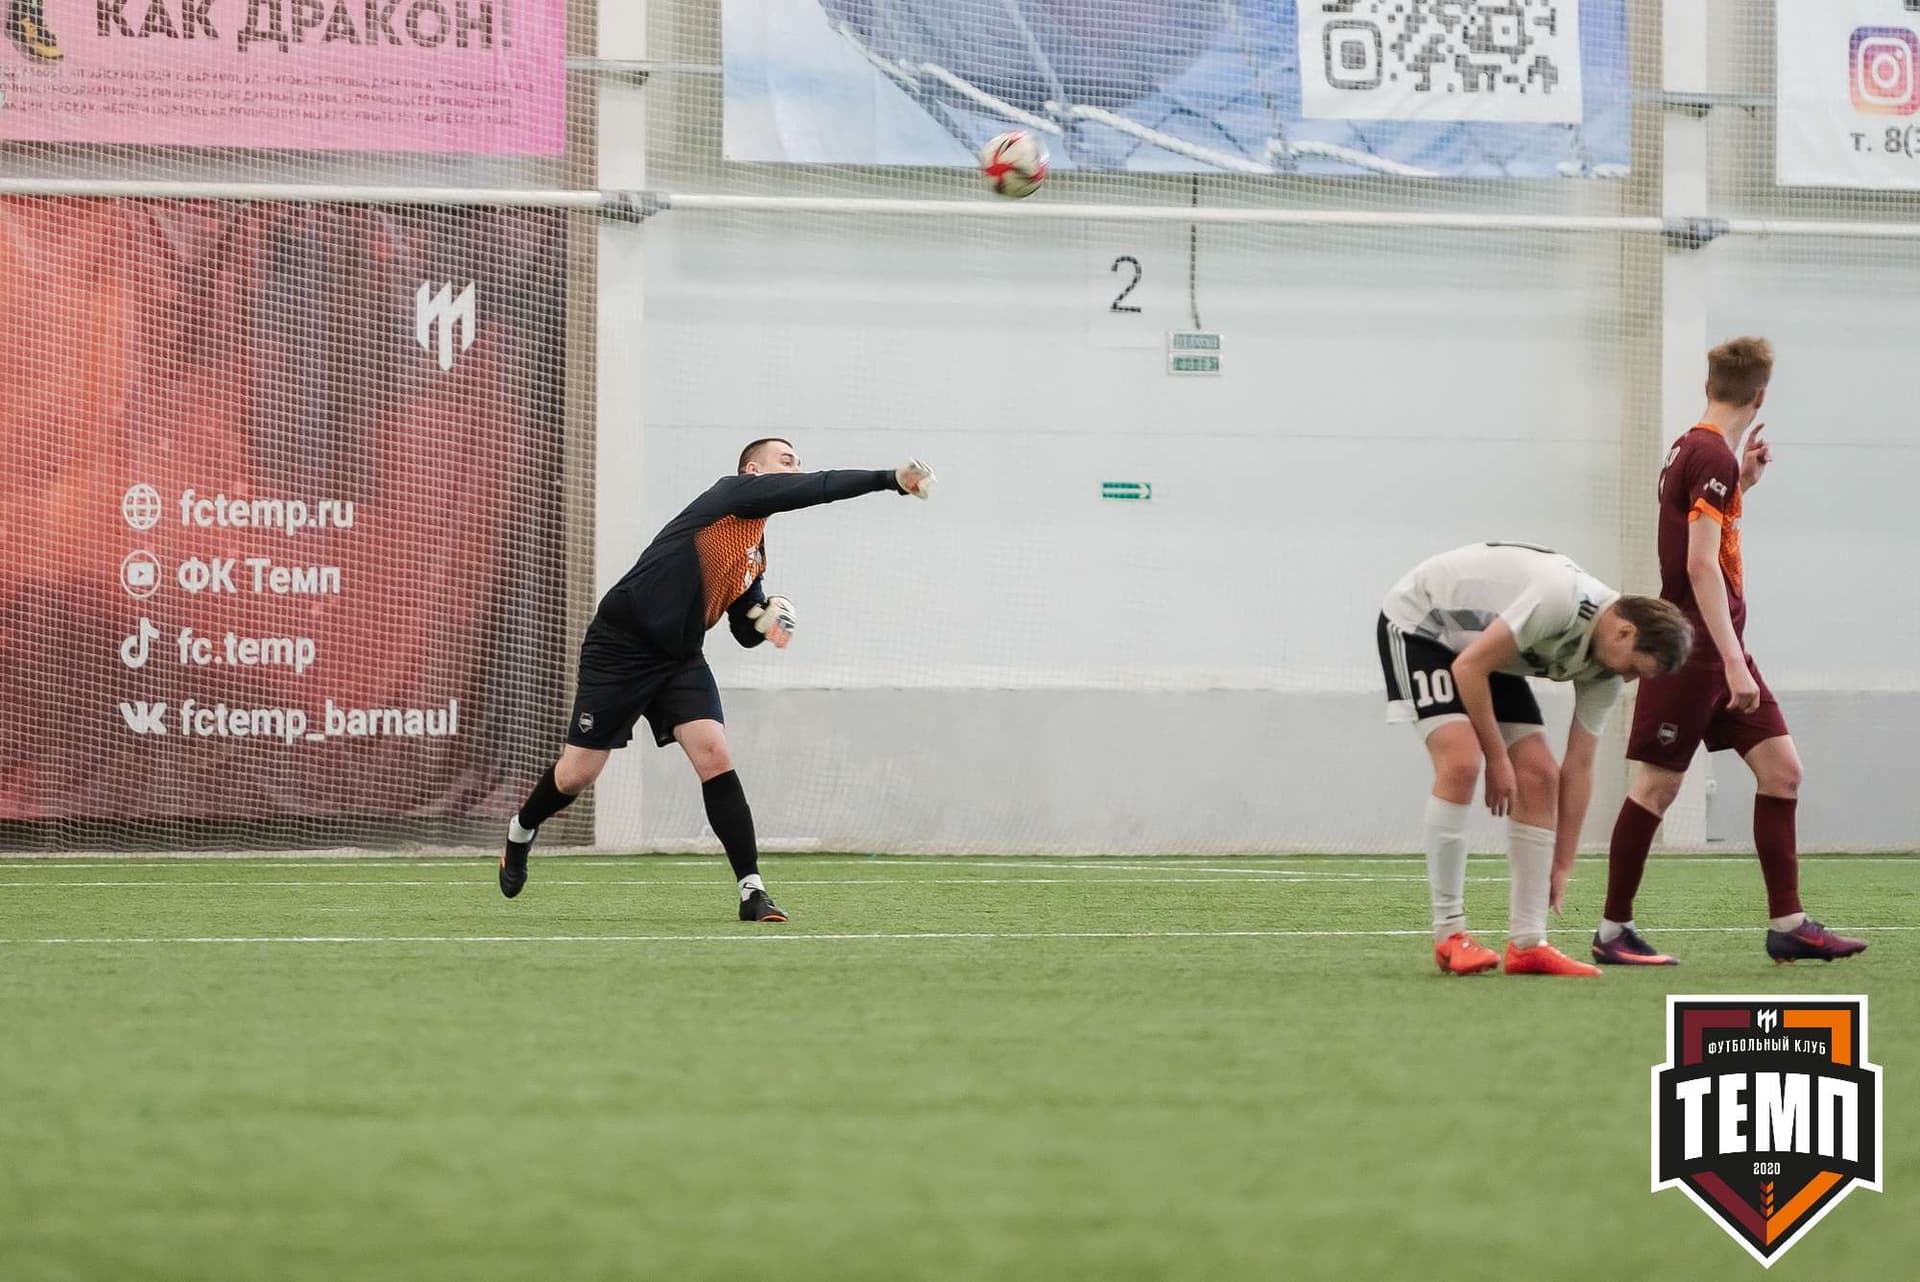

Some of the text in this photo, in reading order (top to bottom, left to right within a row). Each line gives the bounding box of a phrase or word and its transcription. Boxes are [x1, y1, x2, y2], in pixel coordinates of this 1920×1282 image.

[96, 0, 513, 54] КАК ДРАКОН!
[1110, 256, 1142, 313] 2
[179, 488, 355, 536] fctemp.ru
[177, 557, 341, 595] ФК Темп
[177, 628, 316, 673] fc.temp
[1412, 668, 1455, 708] 10
[180, 698, 459, 744] fctemp_barnaul
